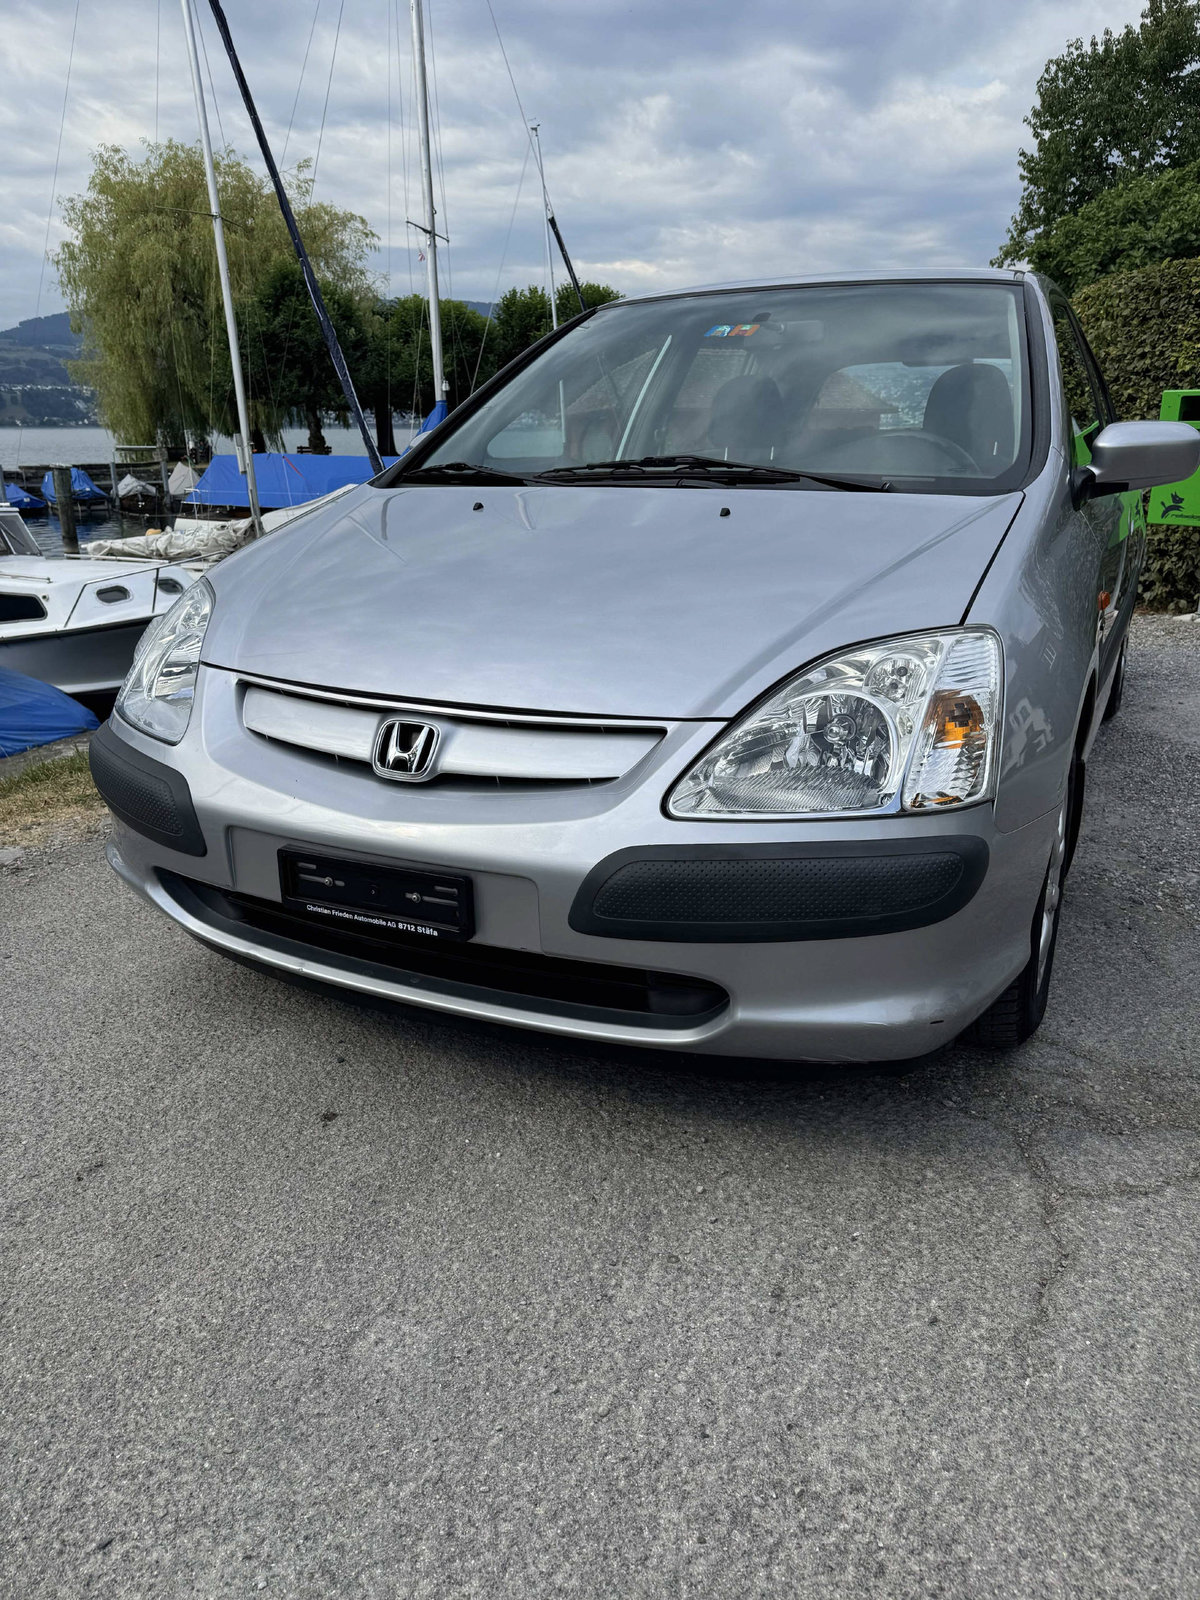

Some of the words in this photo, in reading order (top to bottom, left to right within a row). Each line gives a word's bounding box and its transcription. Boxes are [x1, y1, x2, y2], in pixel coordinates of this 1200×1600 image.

[307, 904, 331, 915] Christian
[332, 909, 353, 919] Frieden
[354, 914, 386, 926] Automobile
[398, 922, 415, 931] 8712
[417, 926, 438, 936] Stäfa
